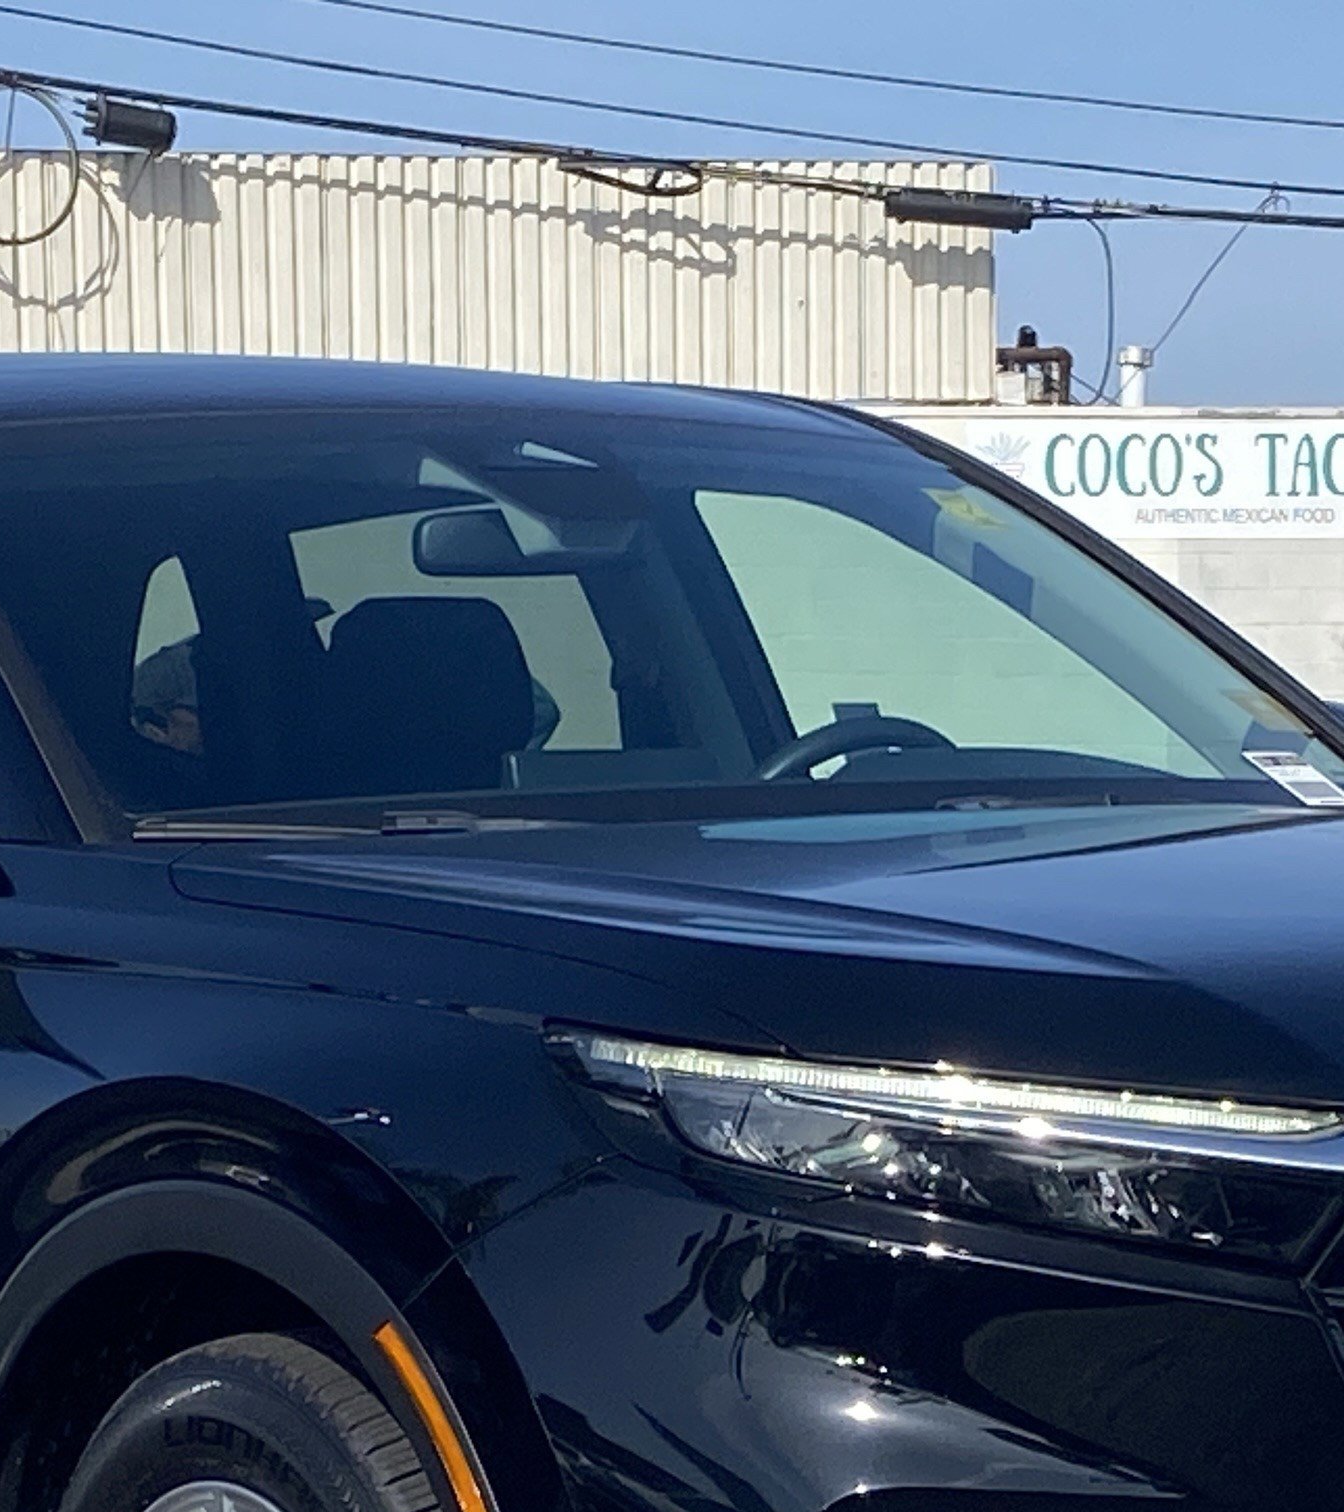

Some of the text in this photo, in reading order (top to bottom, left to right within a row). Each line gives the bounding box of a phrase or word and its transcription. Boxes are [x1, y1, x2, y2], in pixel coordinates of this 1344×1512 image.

[1044, 432, 1224, 497] COCO'S
[1135, 507, 1337, 525] AUTHENTIC MEXICAN FOOD
